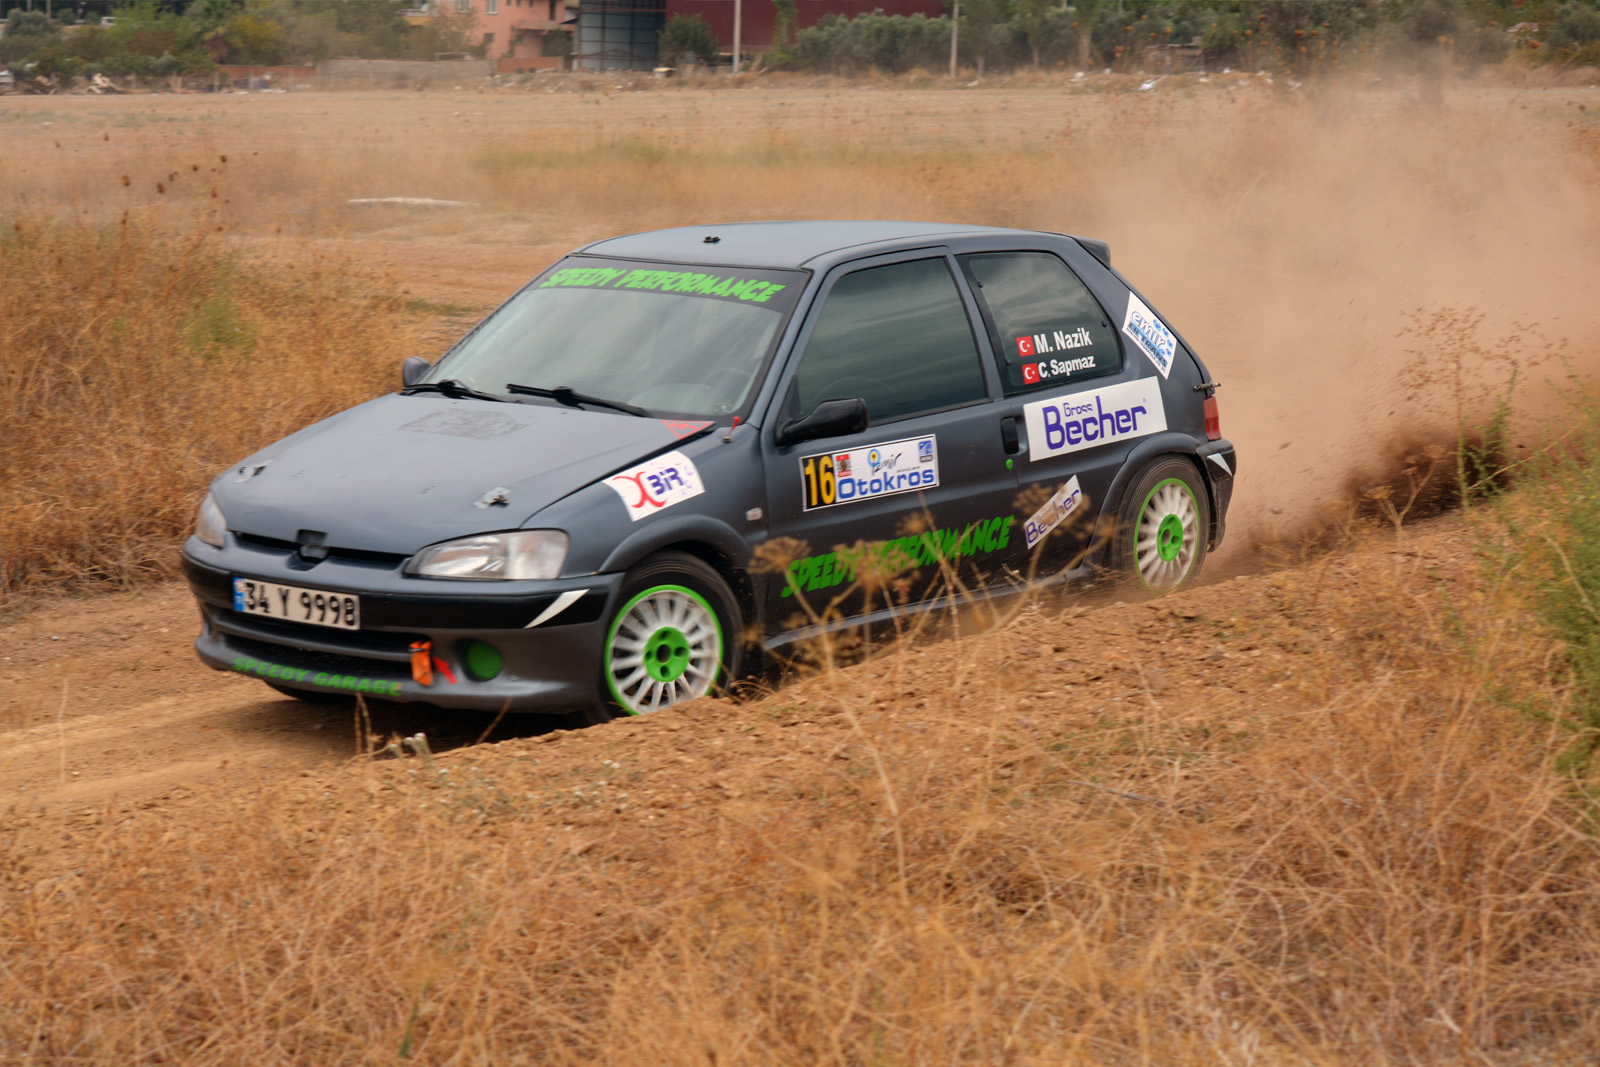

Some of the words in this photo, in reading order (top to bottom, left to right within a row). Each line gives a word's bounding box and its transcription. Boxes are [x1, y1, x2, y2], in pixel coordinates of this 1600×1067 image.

[539, 268, 627, 288] SPEEDY
[614, 269, 787, 302] PERFORMANCE
[1034, 333, 1053, 353] M.
[1053, 327, 1093, 351] Nazik
[1042, 395, 1147, 450] Becher
[1063, 402, 1093, 417] Gross
[804, 455, 836, 506] 16
[838, 469, 934, 499] Otokros
[245, 582, 270, 613] 34
[277, 587, 290, 617] Y
[301, 591, 356, 627] 9998
[232, 656, 311, 682] SPEEDY
[313, 672, 402, 696] GARAGE
